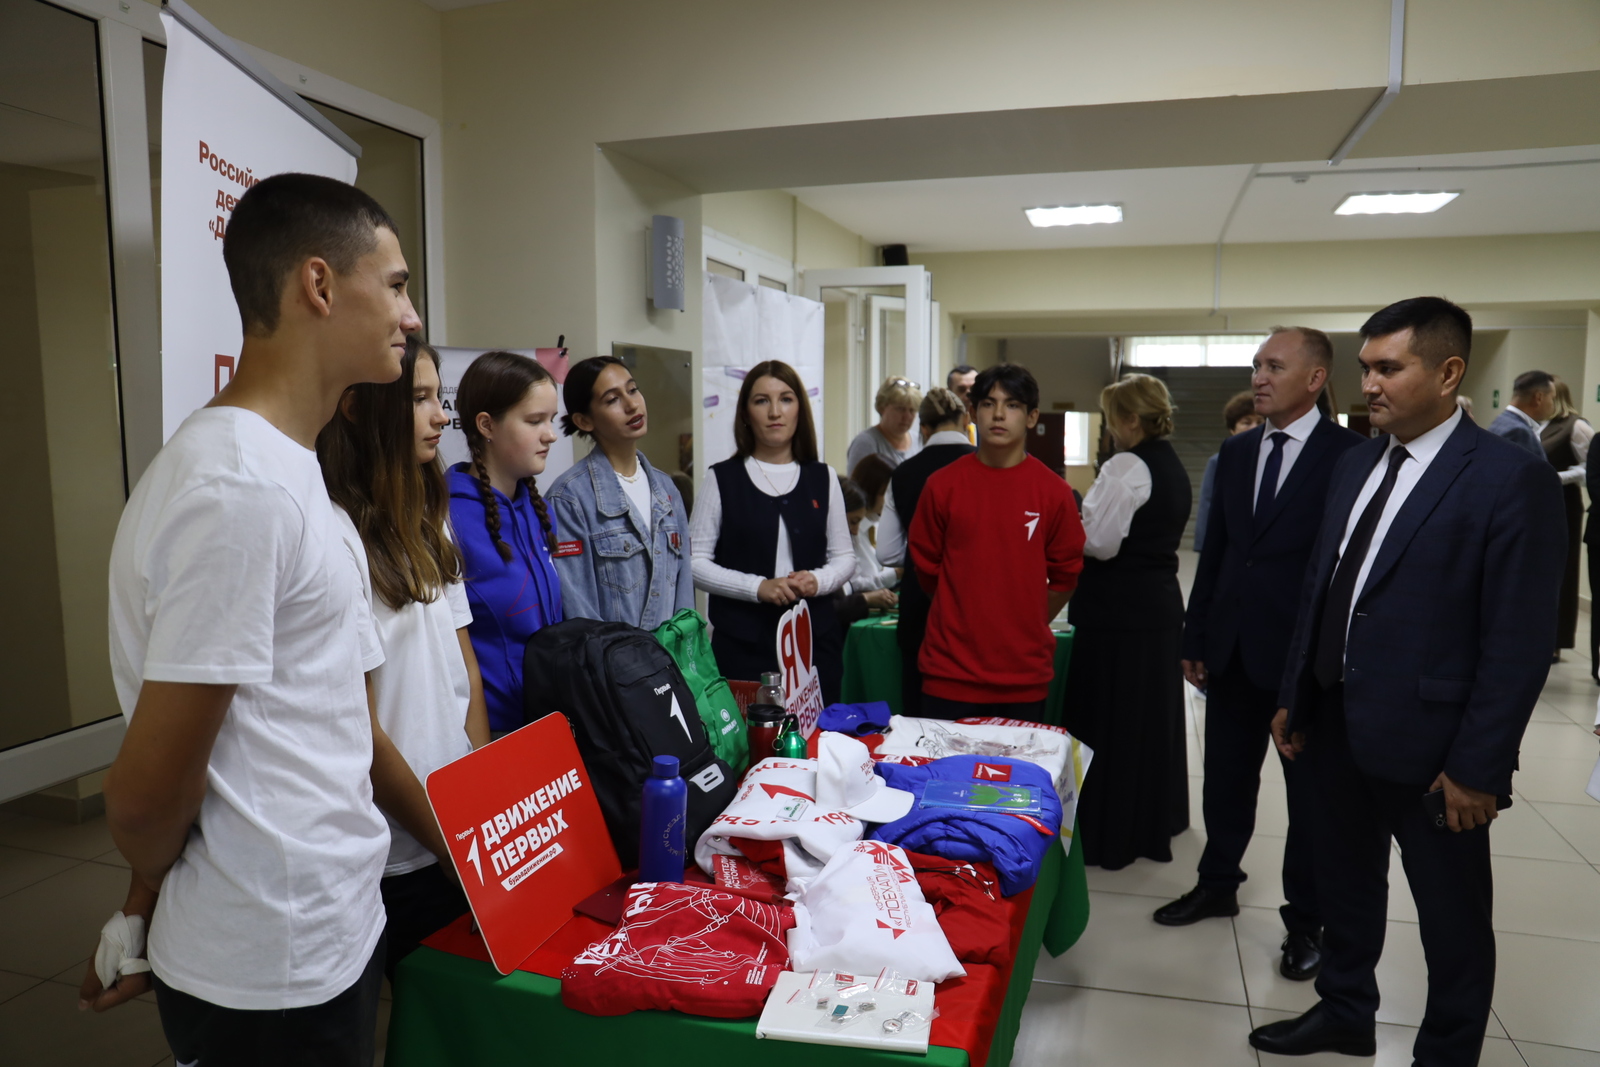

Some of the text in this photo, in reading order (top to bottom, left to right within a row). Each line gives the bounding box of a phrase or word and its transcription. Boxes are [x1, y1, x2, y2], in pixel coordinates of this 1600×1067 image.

[209, 215, 226, 240] «Д
[215, 354, 234, 395] П
[799, 691, 823, 736] РВЫХ
[480, 768, 583, 851] ДВИЖЕНИЕ
[455, 826, 475, 842] Первые
[490, 808, 569, 876] ПЕРВЫХ
[507, 847, 557, 887] будьвдвижении.рф
[721, 856, 732, 887] РАНИТЕЛИ
